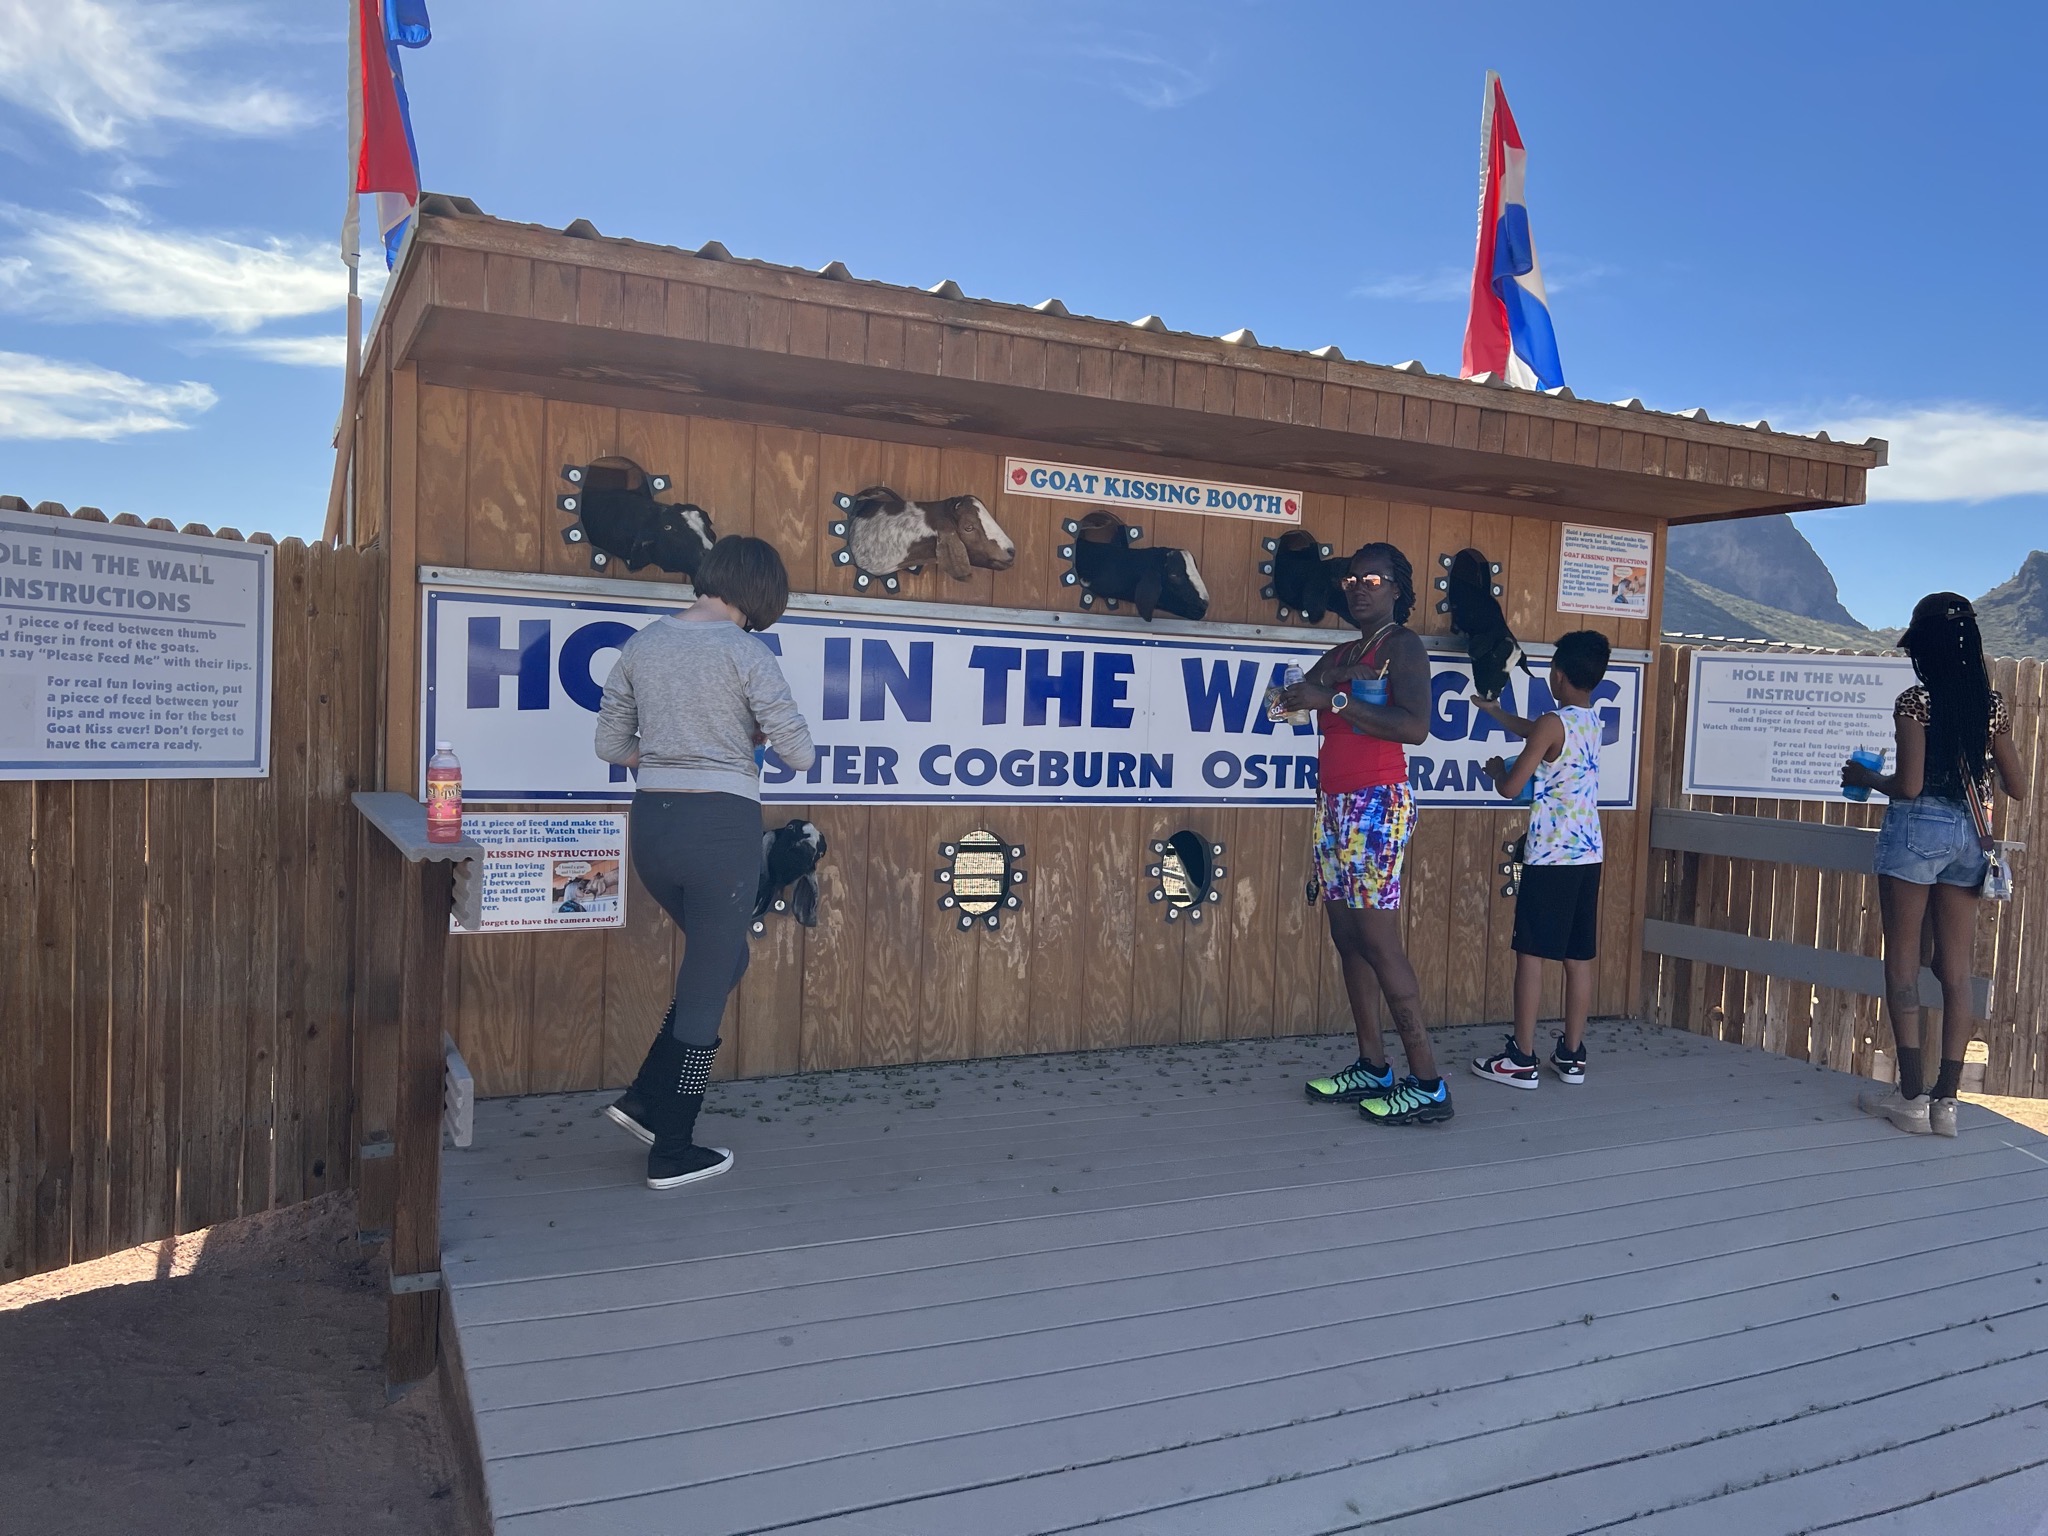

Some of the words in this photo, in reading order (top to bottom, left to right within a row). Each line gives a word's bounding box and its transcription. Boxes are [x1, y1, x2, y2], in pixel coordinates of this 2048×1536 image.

[1030, 468, 1098, 494] GOAT
[1104, 477, 1200, 505] KISSING
[1206, 489, 1282, 515] BOOTH
[52, 549, 82, 571] IN
[92, 553, 140, 577] THE
[147, 560, 215, 585] WALL
[0, 577, 191, 613] NSTRUCTIONS
[5, 614, 12, 625] 1
[19, 615, 59, 629] piece
[64, 619, 79, 630] of
[83, 620, 114, 632] feed
[118, 622, 174, 637] between
[178, 627, 217, 640] thumb
[14, 631, 57, 646] finger
[62, 634, 75, 646] in
[80, 635, 114, 648] front
[118, 639, 132, 649] of
[136, 640, 157, 651] the
[161, 643, 199, 654] goats.
[10, 649, 34, 661] say
[97, 652, 130, 664] Feed
[164, 656, 191, 668] with
[195, 657, 223, 670] their
[227, 659, 252, 672] lips.
[1732, 669, 1775, 682] HOLE
[1780, 671, 1798, 683] IN
[1804, 671, 1833, 684] THE
[1838, 673, 1883, 686] WALL
[48, 675, 70, 687] For
[74, 677, 102, 688] real
[107, 678, 128, 689] fun
[132, 679, 172, 693] loving
[176, 681, 218, 695] action,
[222, 684, 242, 695] put
[823, 637, 934, 722] IN
[968, 645, 1136, 729] THE
[1181, 657, 1315, 736] WA
[47, 693, 56, 702] a
[60, 691, 99, 705] piece
[103, 693, 118, 704] of
[122, 693, 152, 705] feed
[155, 694, 208, 707] between
[212, 699, 239, 709] your
[1746, 687, 1866, 704] INSTRUCTIONS
[47, 706, 73, 720] lips
[78, 708, 104, 719] and
[109, 711, 145, 720] move
[149, 709, 161, 720] in
[165, 710, 184, 721] for
[188, 711, 207, 721] the
[211, 711, 236, 722] best
[1728, 706, 1750, 714] Hold
[1759, 708, 1783, 716] piece
[1796, 709, 1816, 717] feed
[1817, 710, 1854, 719] between
[1855, 712, 1883, 720] thumb
[1756, 716, 1781, 725] finger
[1793, 718, 1815, 726] front
[1828, 719, 1842, 727] the
[1844, 721, 1870, 729] goats.
[46, 722, 80, 734] Goat
[85, 723, 113, 734] Kiss
[117, 724, 150, 735] ever!
[192, 725, 229, 738] forget
[232, 727, 244, 736] to
[1702, 722, 1728, 731] Watch
[1730, 724, 1751, 732] them
[1753, 726, 1767, 734] say
[1845, 729, 1864, 737] with
[1866, 730, 1887, 738] their
[46, 738, 80, 749] have
[85, 738, 106, 749] the
[110, 741, 160, 750] camera
[164, 739, 202, 752] ready.
[1824, 743, 1851, 752] loving
[1780, 750, 1804, 758] piece
[919, 745, 1173, 788] COGBURN
[1201, 751, 1319, 790] OSTR
[1408, 756, 1494, 791] RAN
[1772, 758, 1788, 766] lips
[1834, 760, 1842, 768] in
[1771, 766, 1792, 774] Goat
[1794, 767, 1811, 775] Kiss
[1770, 775, 1791, 783] have
[1793, 776, 1807, 784] the
[462, 819, 478, 827] old
[489, 819, 514, 828] piece
[516, 819, 527, 827] of
[528, 819, 549, 827] feed
[551, 819, 569, 827] and
[571, 819, 597, 827] make
[598, 819, 615, 827] the
[512, 827, 528, 835] for
[529, 827, 541, 835] it.
[545, 827, 576, 835] Watch
[577, 827, 601, 835] their
[603, 827, 620, 836] lips
[517, 835, 579, 844] anticipation.
[487, 850, 535, 859] KISSING
[537, 849, 620, 858] INSTRUCTIONS
[515, 862, 545, 871] loving
[490, 871, 508, 879] put
[518, 871, 543, 879] piece
[483, 888, 498, 896] ips
[524, 895, 546, 903] goat
[480, 920, 508, 928] forget
[543, 917, 558, 925] the
[592, 915, 619, 923] ready!
